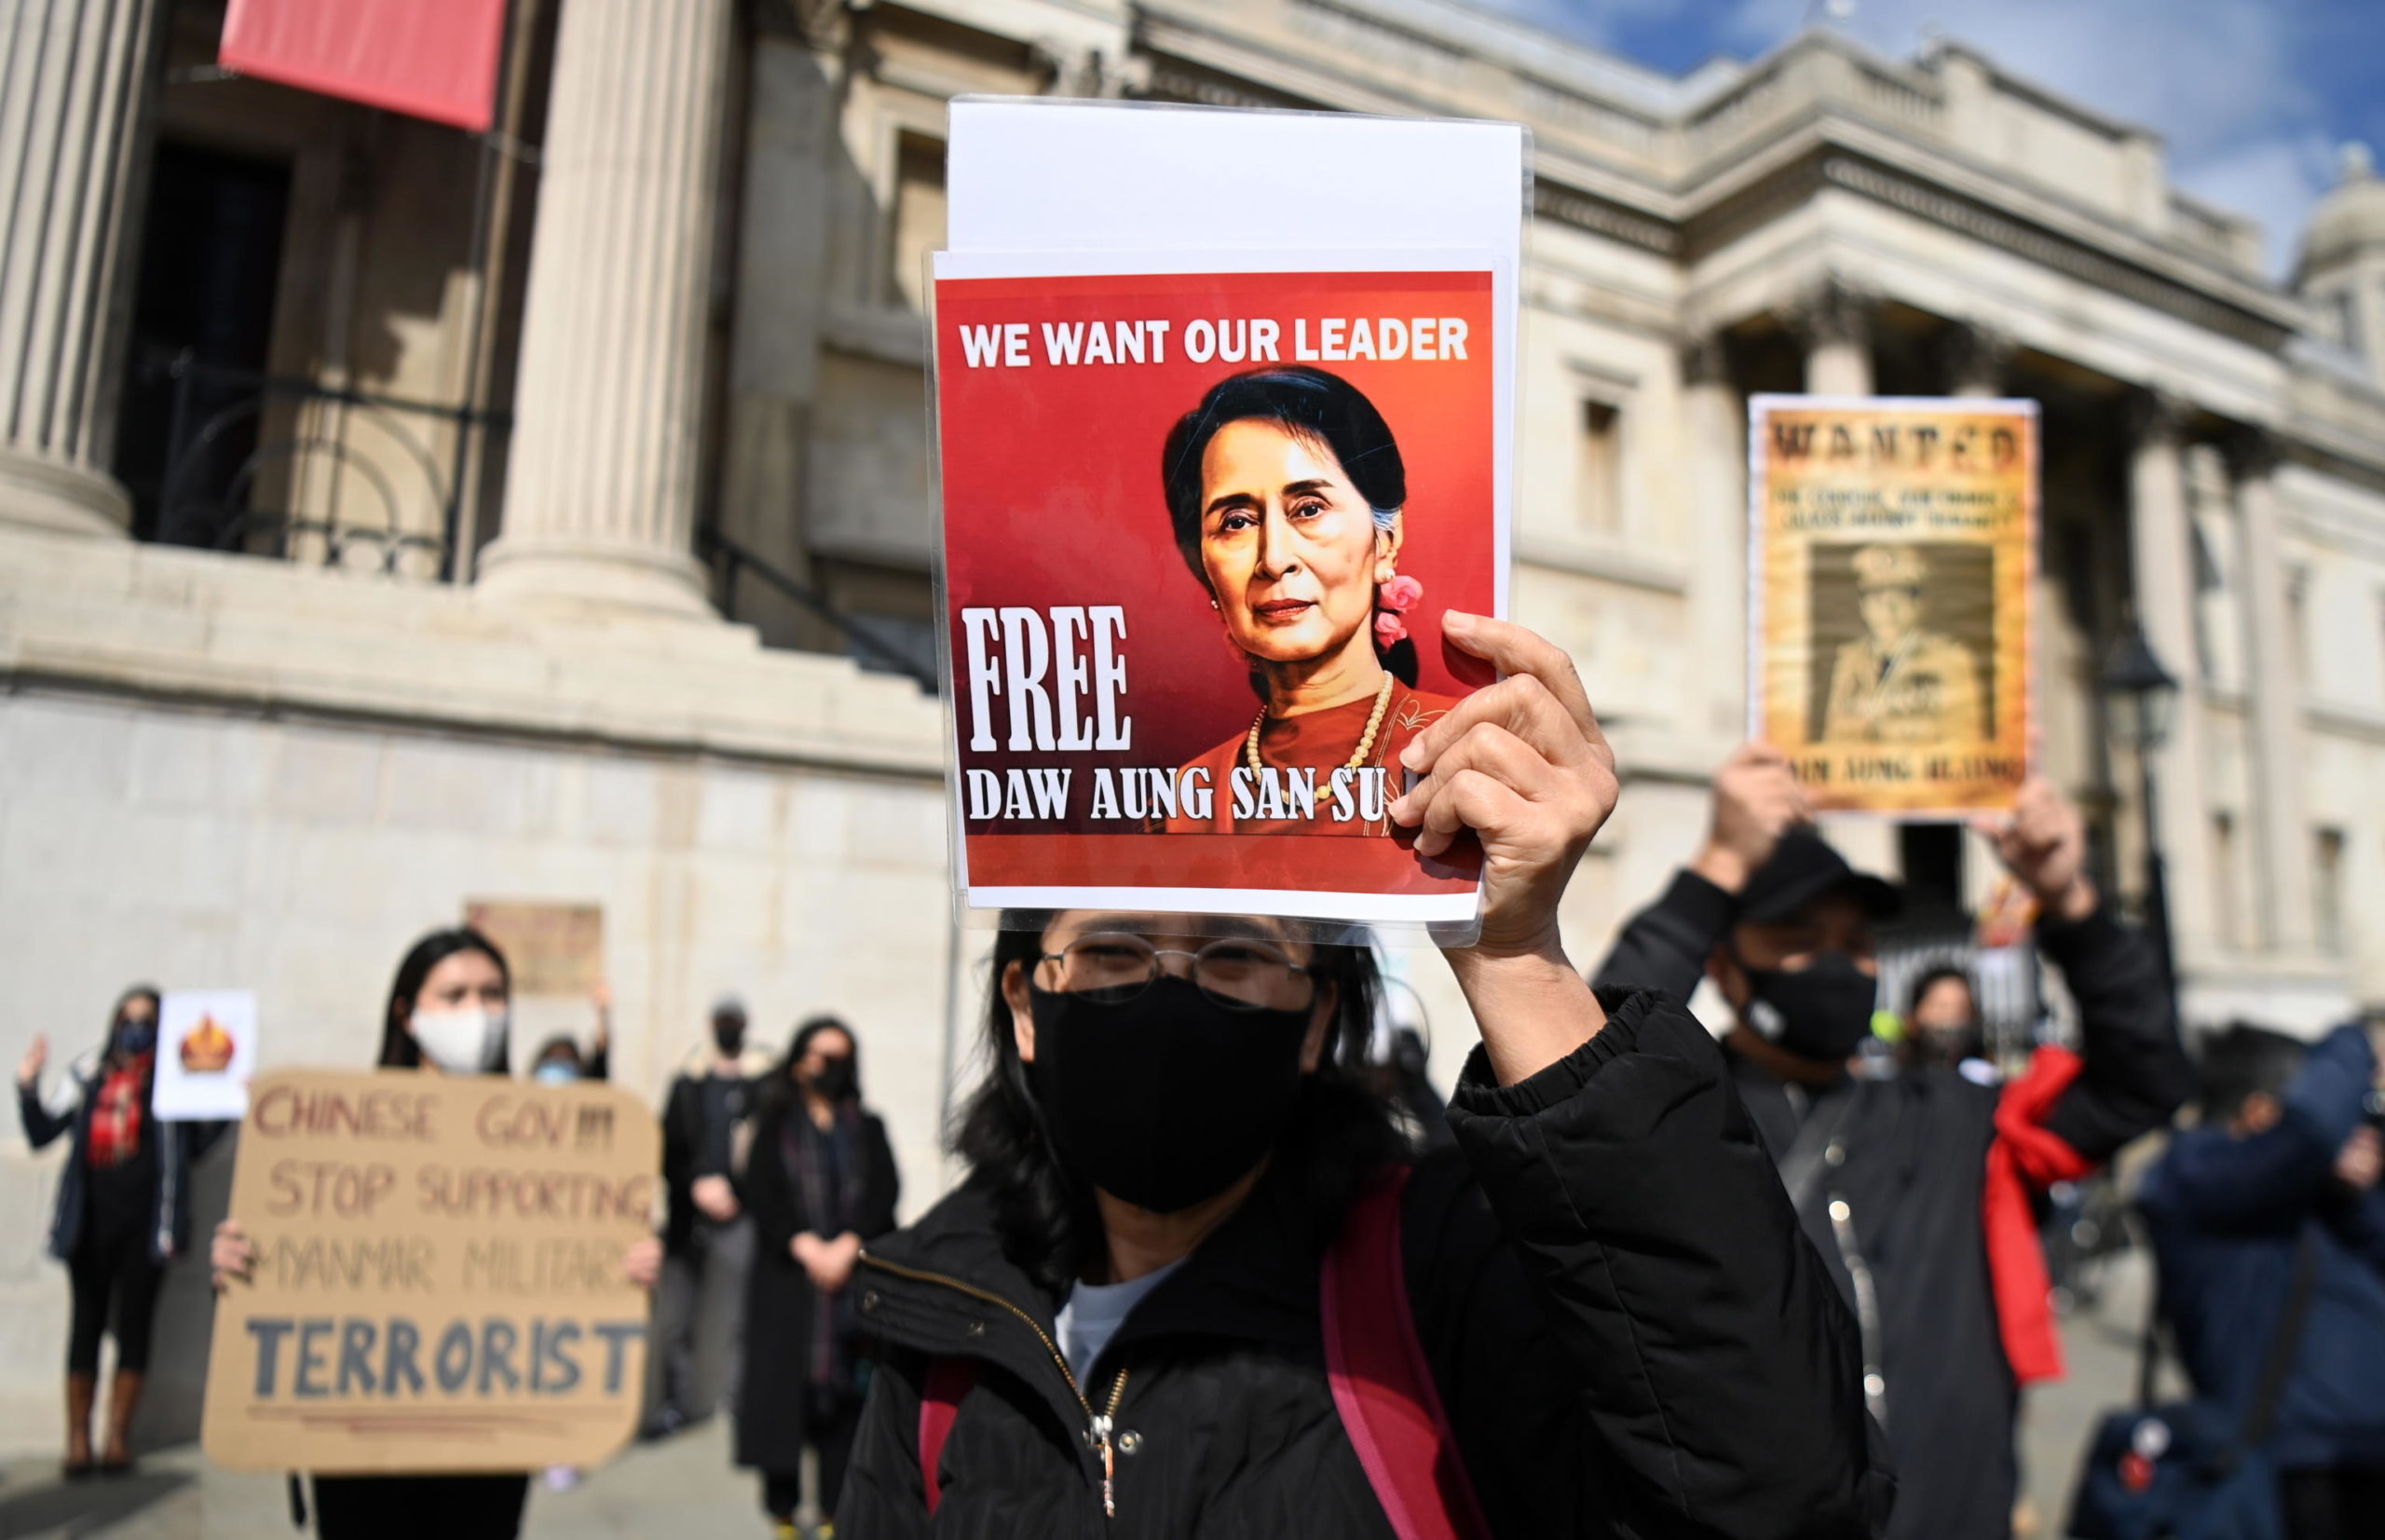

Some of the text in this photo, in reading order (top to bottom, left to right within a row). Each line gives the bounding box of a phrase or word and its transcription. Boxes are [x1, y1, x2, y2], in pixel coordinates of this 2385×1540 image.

[960, 318, 1469, 367] WE WANT OUR LEADER
[1774, 425, 2018, 472] WANTED
[961, 606, 1131, 751] FREE
[967, 770, 1071, 820] DAW
[1091, 769, 1213, 819] AUNG
[1232, 768, 1315, 818] SAN
[1333, 767, 1386, 821] SU
[254, 1086, 437, 1139] CHINESE
[267, 1160, 652, 1223] STOP SUPPORTING
[246, 1318, 647, 1399] TERRORIST
